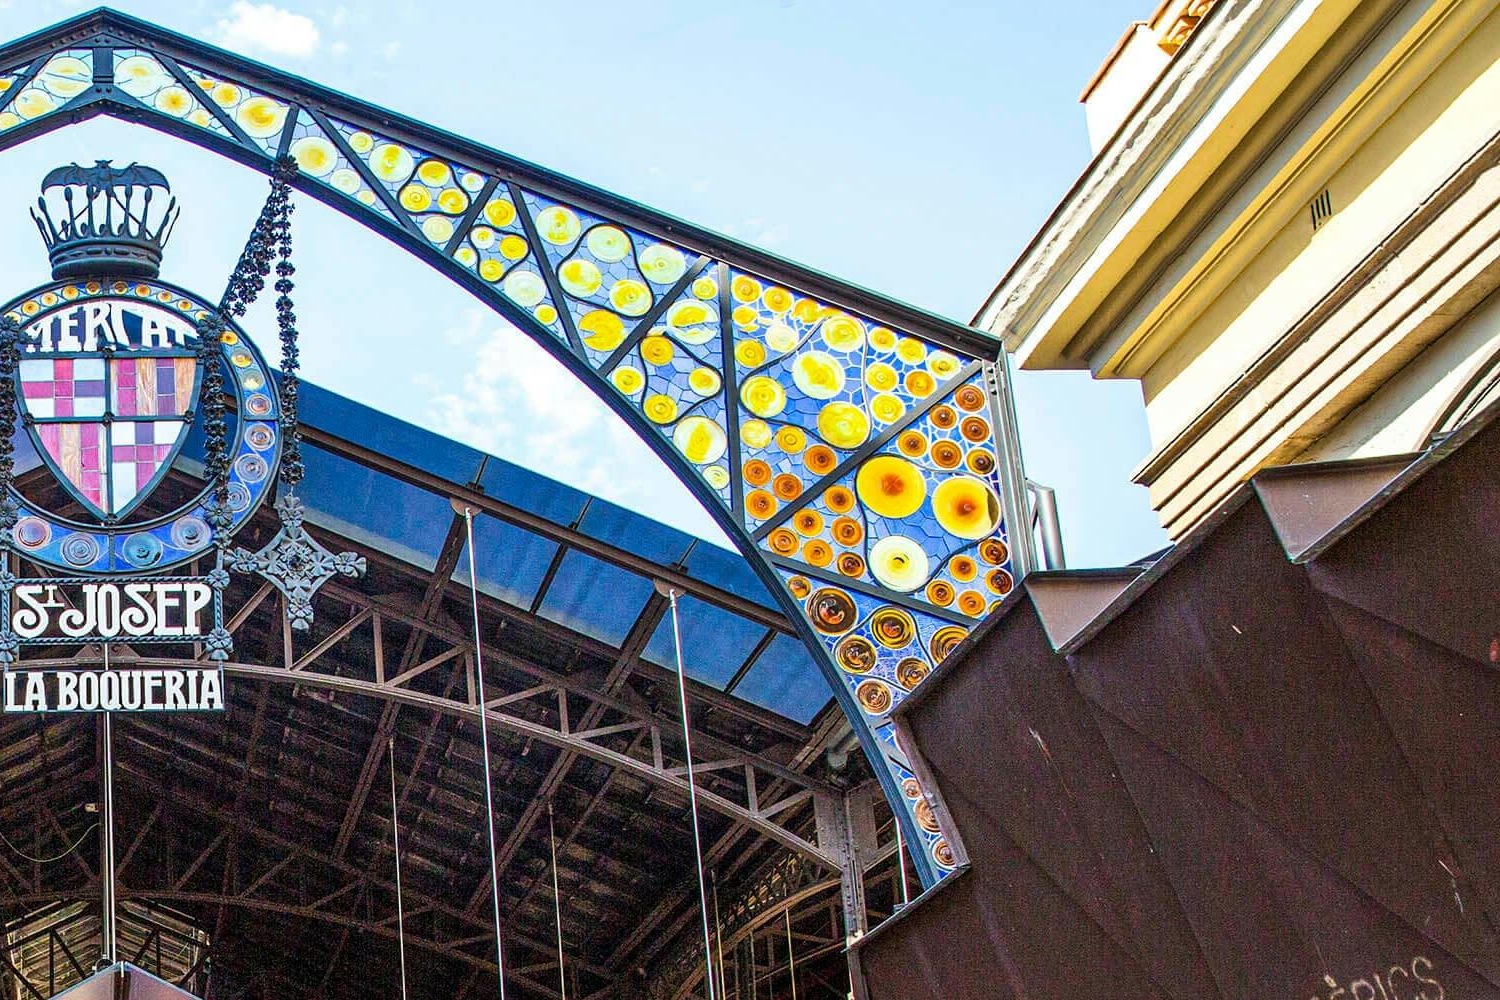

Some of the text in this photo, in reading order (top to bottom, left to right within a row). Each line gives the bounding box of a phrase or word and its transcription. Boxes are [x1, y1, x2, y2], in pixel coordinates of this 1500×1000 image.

[59, 583, 212, 638] JOSEP
[5, 671, 224, 711] LA BOQUERIA
